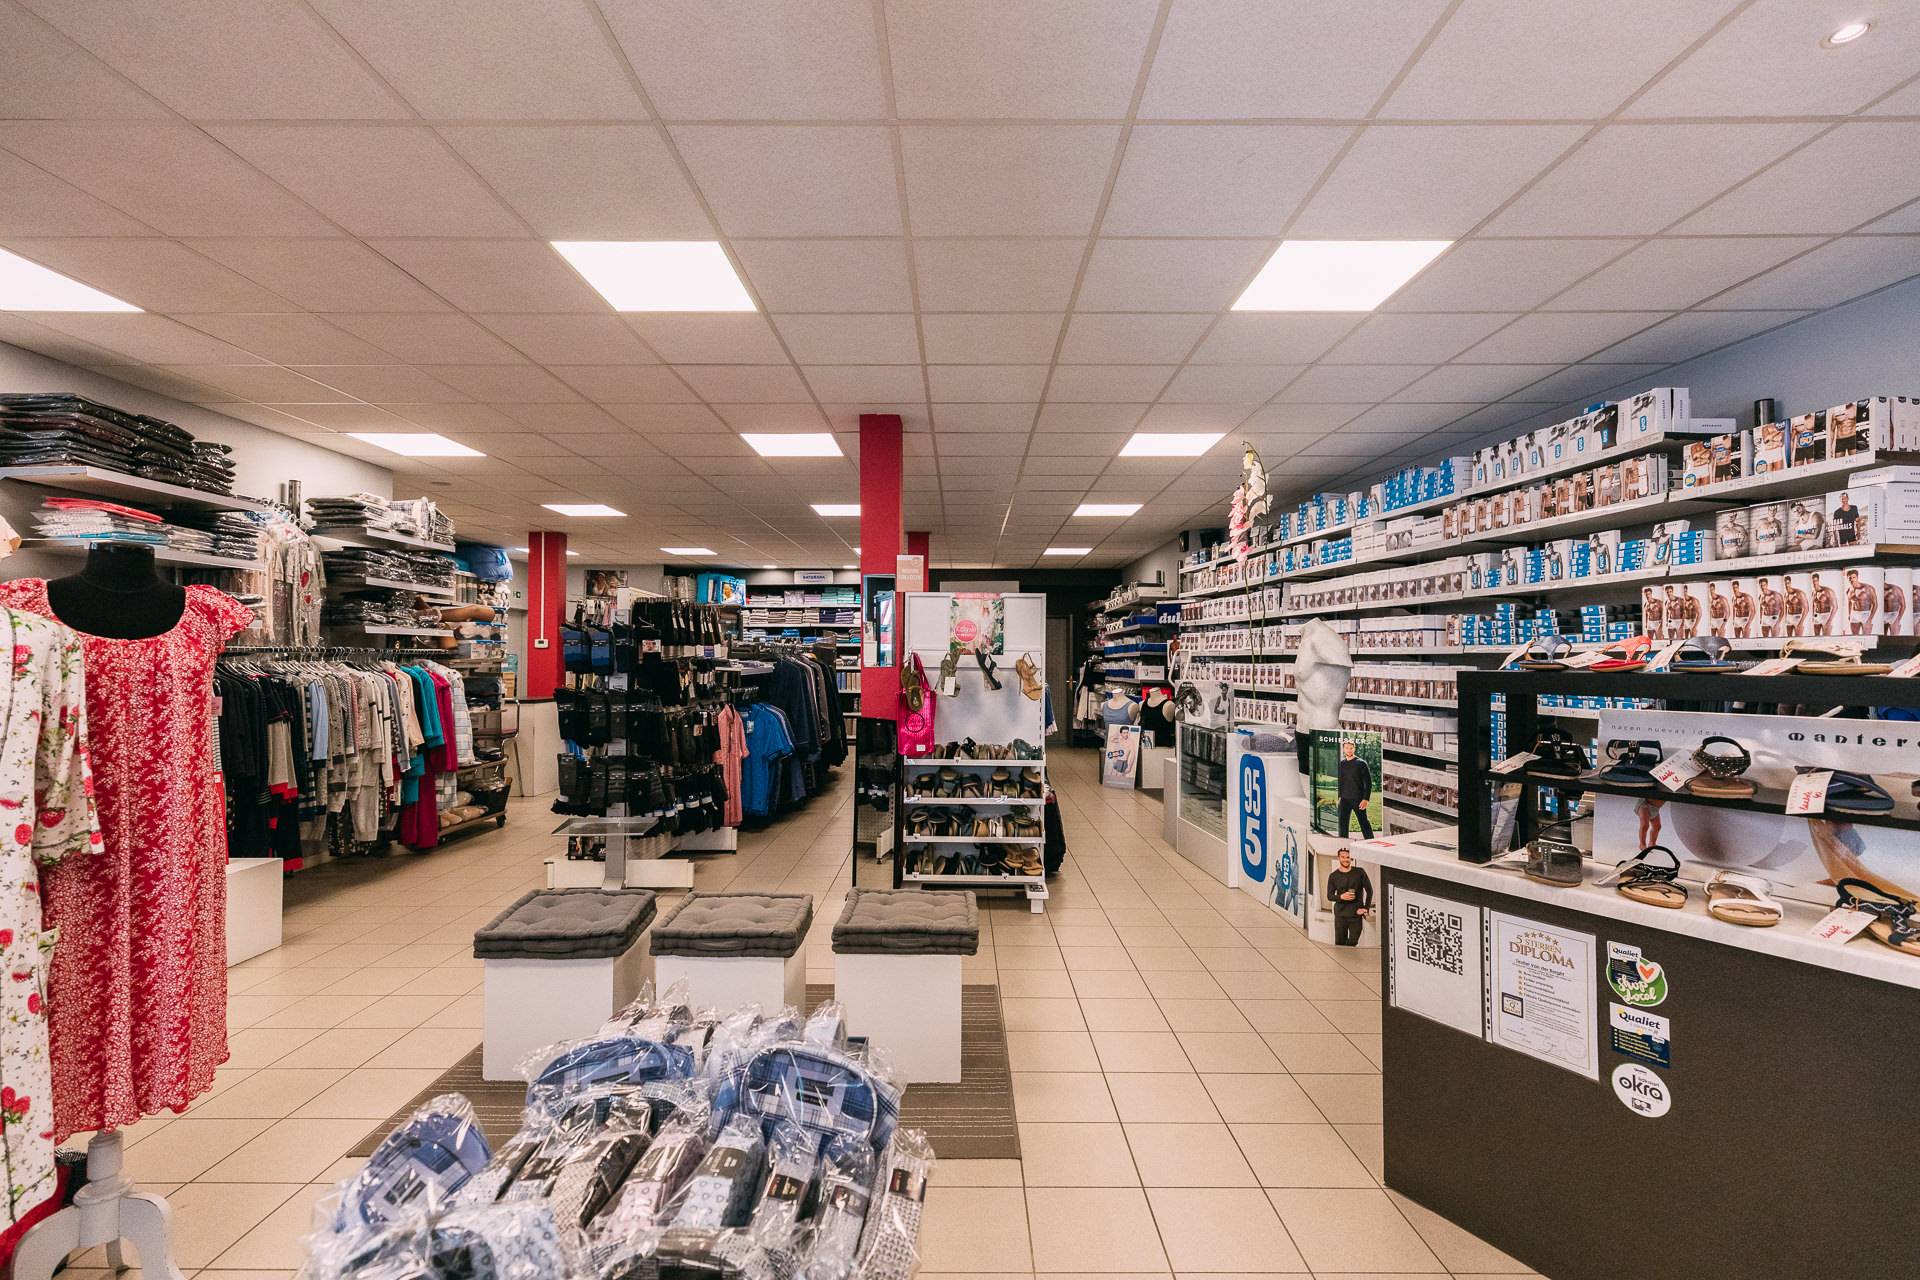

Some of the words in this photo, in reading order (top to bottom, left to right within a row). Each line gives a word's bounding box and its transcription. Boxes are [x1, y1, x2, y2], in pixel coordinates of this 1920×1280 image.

[1244, 766, 1260, 817] 95
[1244, 816, 1263, 867] 5
[1516, 934, 1523, 944] 5
[1612, 947, 1639, 958] Qualiet
[1509, 941, 1575, 970] DIPLOMA
[1619, 1011, 1661, 1030] Qualiet
[1619, 1074, 1663, 1101] okra
